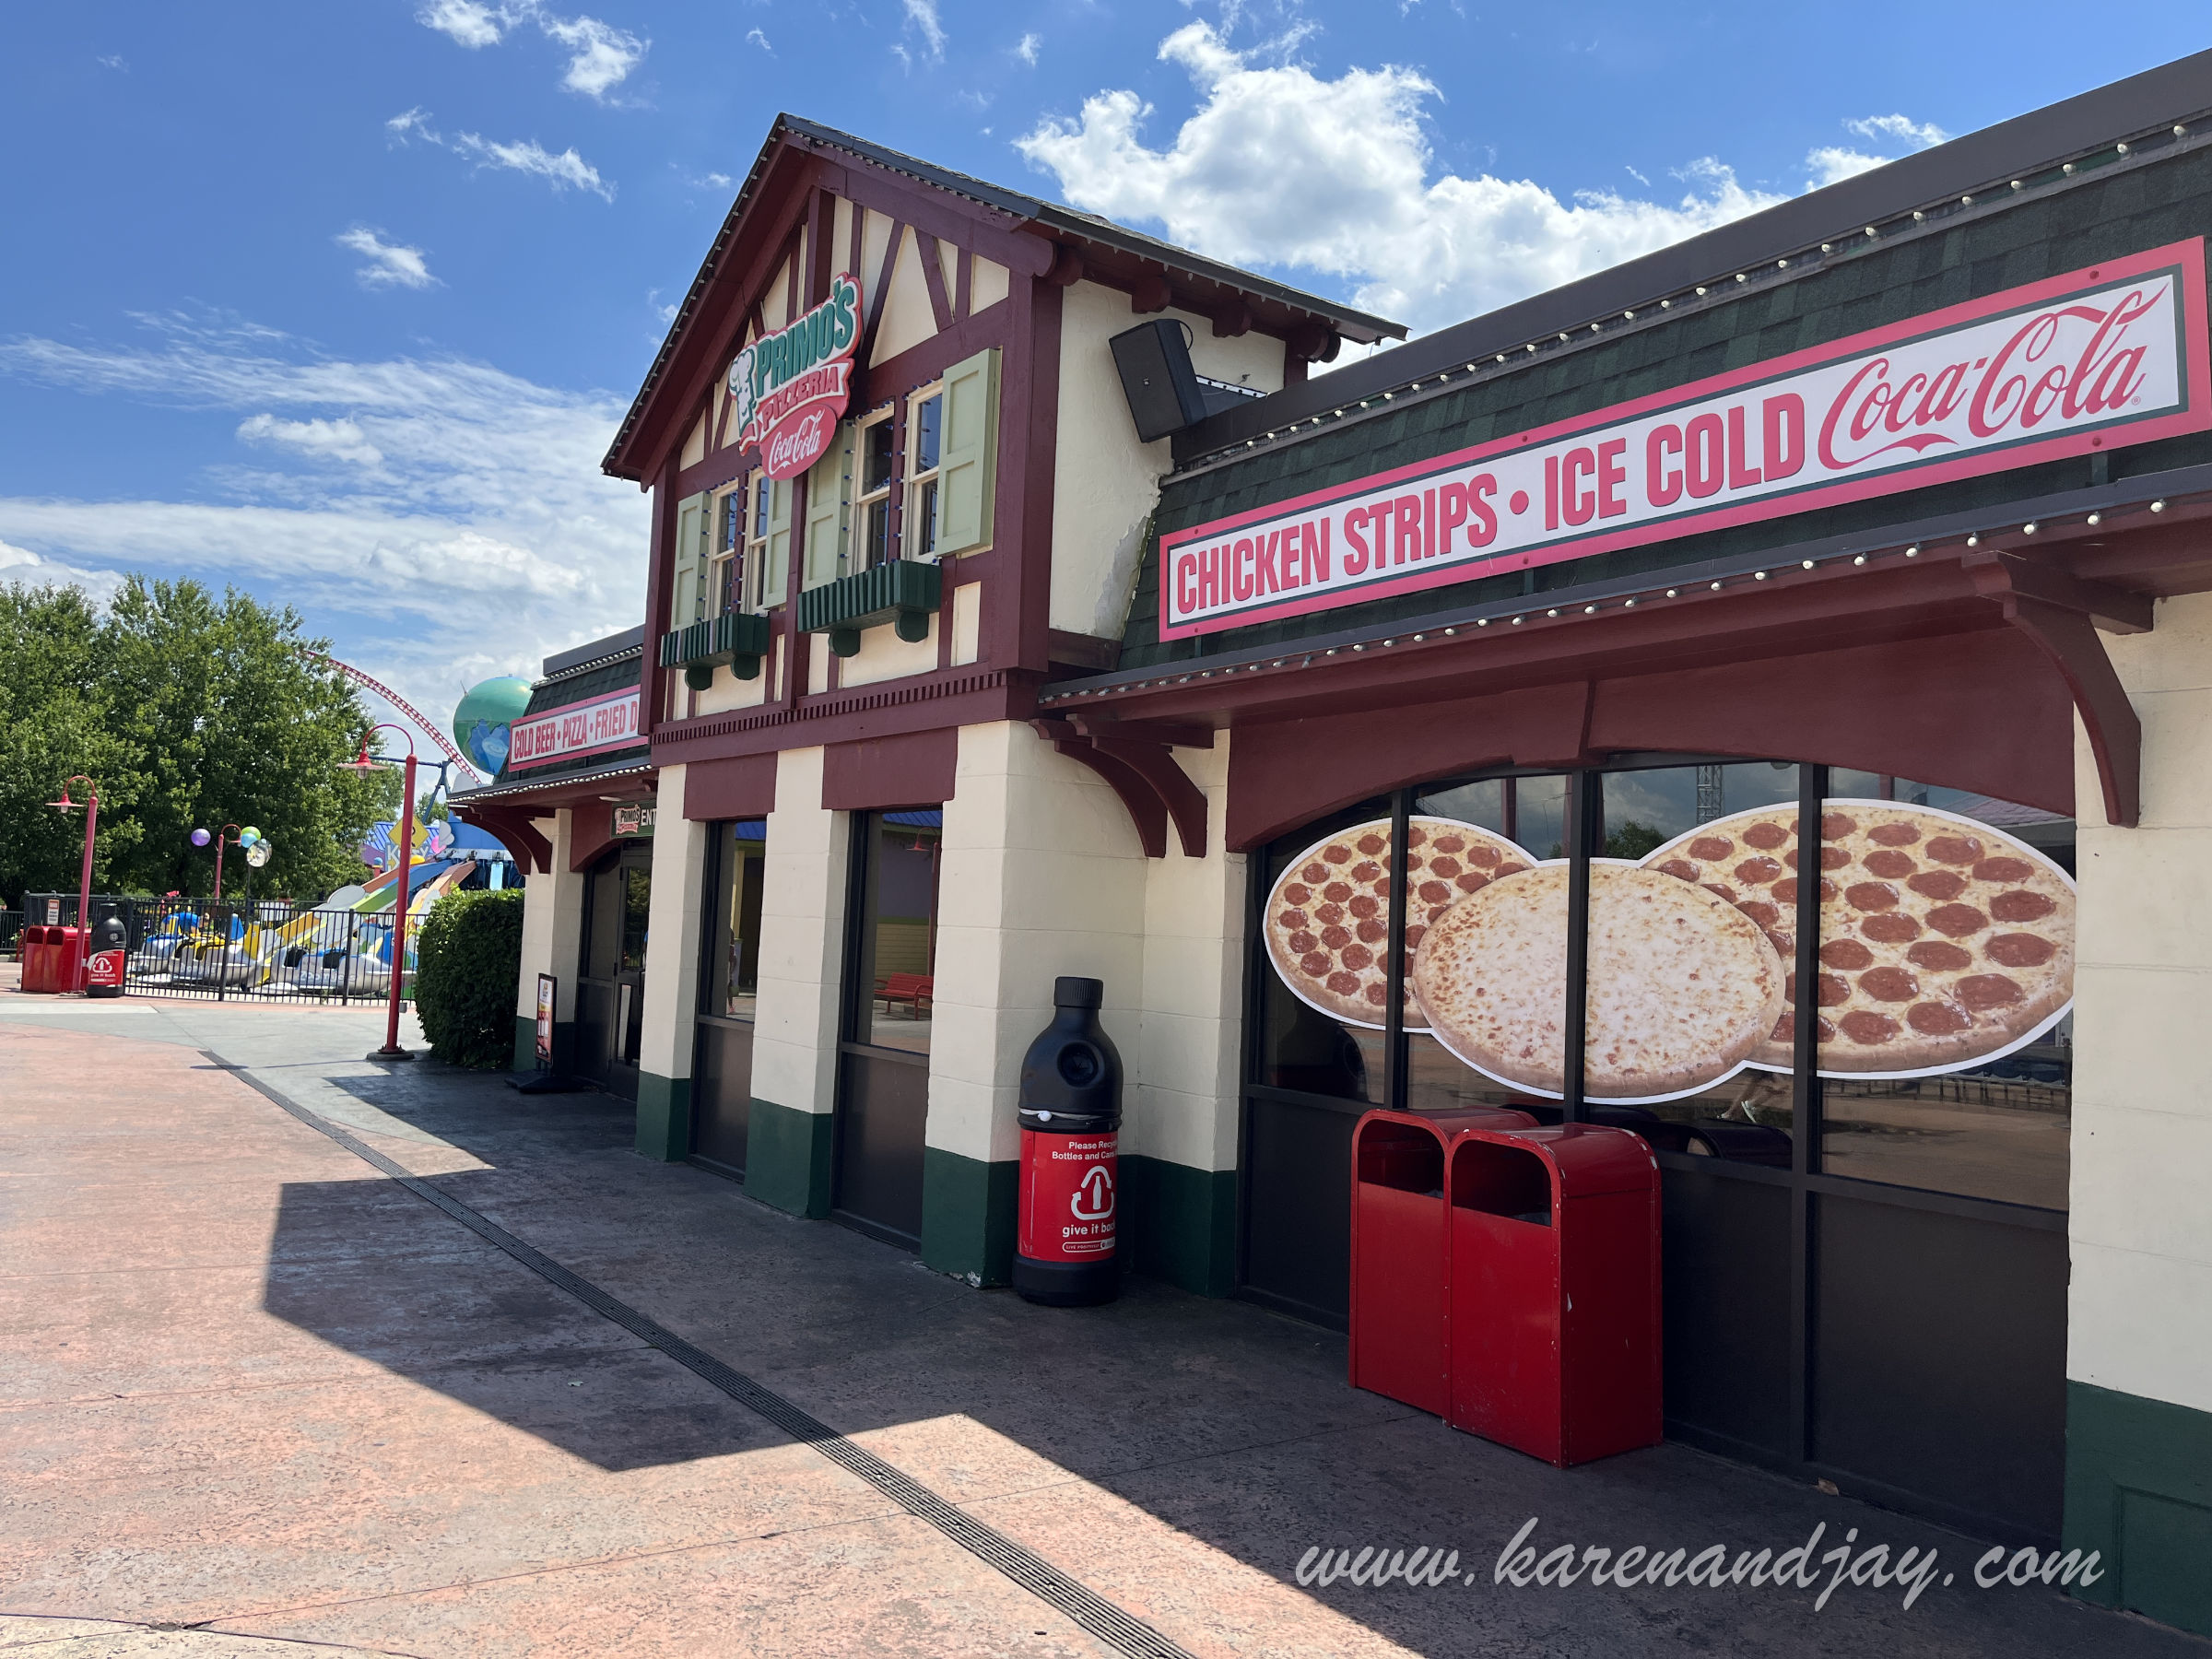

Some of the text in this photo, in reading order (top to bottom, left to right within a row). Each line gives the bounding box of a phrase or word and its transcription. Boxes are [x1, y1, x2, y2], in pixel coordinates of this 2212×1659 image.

[756, 279, 854, 399] PRIMO'S
[763, 367, 840, 432] PIZZERIA
[769, 408, 826, 476] Coca-Cola
[1176, 281, 2171, 615] CHICKEN STRIPS ICE COLD Coca-Cola
[514, 727, 535, 759] COLD
[535, 722, 557, 755] BEER
[562, 713, 588, 748] PIZZA
[594, 703, 627, 741] FRIED
[1052, 1151, 1083, 1160] Bottles
[1084, 1152, 1100, 1160] and
[1069, 1141, 1098, 1149] Please
[1062, 1224, 1088, 1238] give
[1091, 1223, 1100, 1235] it
